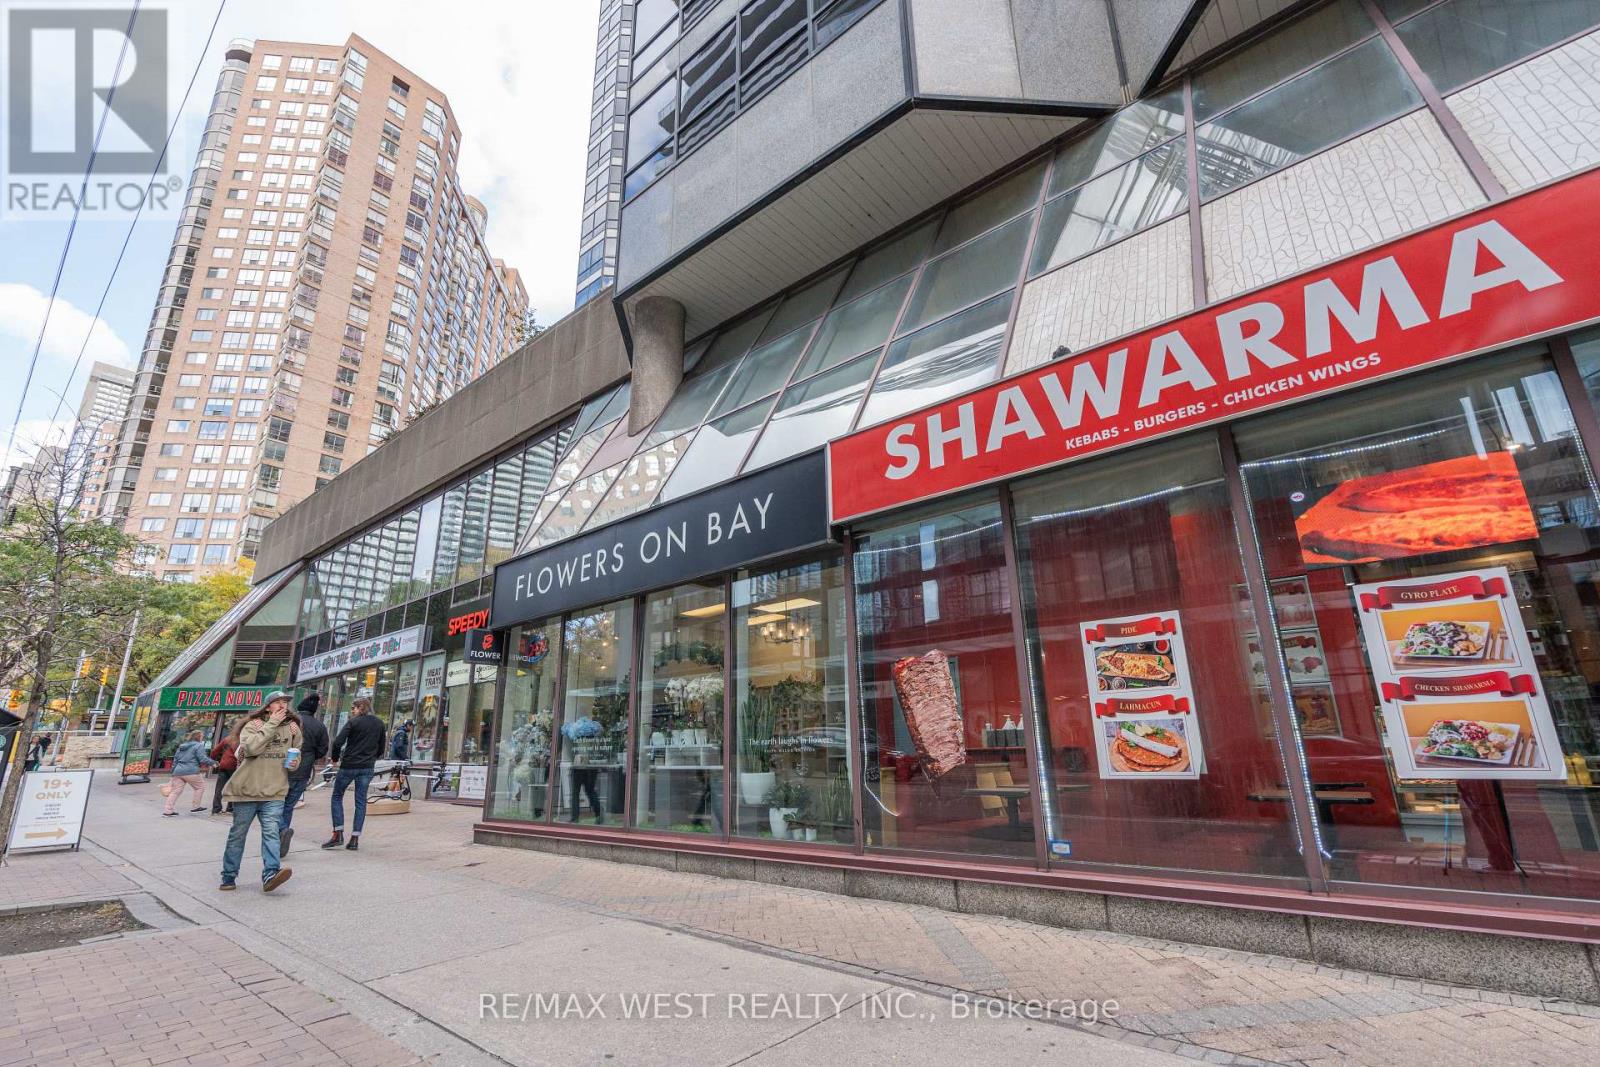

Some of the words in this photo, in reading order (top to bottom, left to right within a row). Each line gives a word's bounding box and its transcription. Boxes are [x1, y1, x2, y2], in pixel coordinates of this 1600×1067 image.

[884, 219, 1565, 481] SHAWARMA
[1065, 425, 1119, 450] KEBABS
[1134, 402, 1206, 432] BURGERS
[1223, 374, 1304, 406] CHICKEN
[1308, 352, 1382, 382] WINGS
[515, 542, 624, 601] FLOWERS
[639, 521, 687, 564] ON
[707, 492, 774, 545] BAY
[1400, 590, 1428, 600] GYRO
[1430, 585, 1461, 598] PLATE
[447, 609, 489, 636] SPEEDY
[1120, 625, 1138, 635] PIDE
[470, 650, 501, 660] FLOWER
[427, 667, 442, 677] MEAT
[1452, 679, 1496, 692] SHAWARMA
[176, 691, 221, 707] PIZZA
[225, 690, 262, 707] NOVA
[1119, 700, 1162, 711] LAHMACUN
[43, 779, 72, 789] 19+
[35, 791, 72, 800] ONLY
